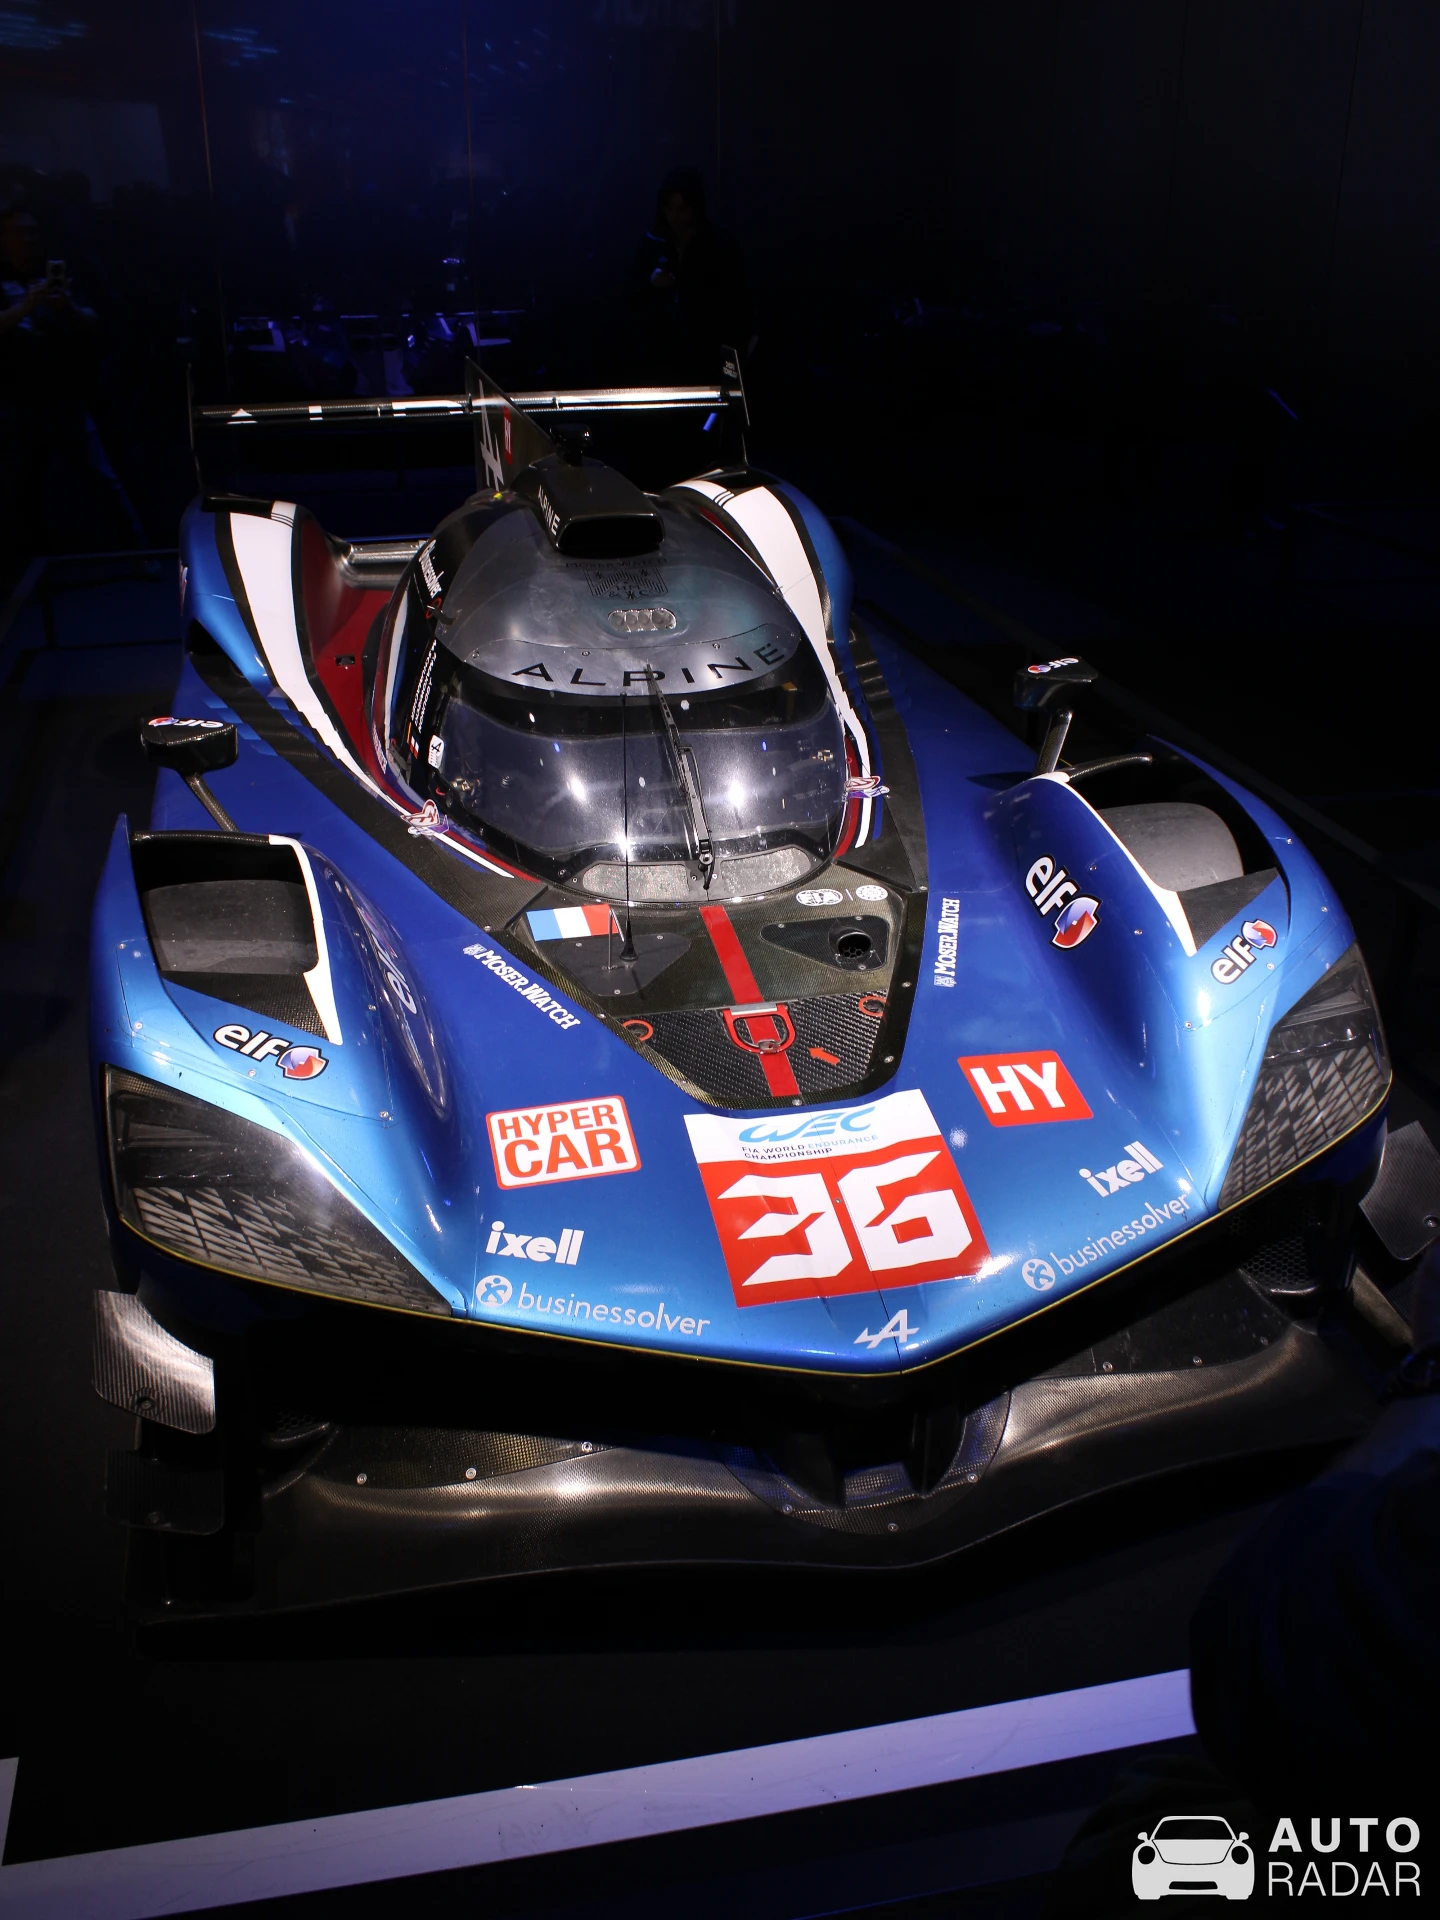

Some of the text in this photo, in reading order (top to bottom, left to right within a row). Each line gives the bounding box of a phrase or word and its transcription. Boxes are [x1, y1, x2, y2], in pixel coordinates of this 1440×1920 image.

[537, 484, 561, 536] ALPINE
[512, 643, 786, 687] ALPINE
[1025, 856, 1078, 916] elf
[370, 933, 417, 1015] elf
[1212, 936, 1257, 984] elf
[474, 949, 581, 1030] MOSER.WATCH
[214, 1024, 291, 1061] elf
[969, 1061, 1066, 1114] HY
[497, 1104, 618, 1141] HYPER
[738, 1106, 876, 1143] WEC
[741, 1134, 879, 1154] FIA WORLD ENDURANCE
[504, 1128, 629, 1179] CAR
[744, 1148, 833, 1160] CHAMPIONSHIP
[1079, 1140, 1164, 1198] ixell
[485, 1221, 585, 1266] ixell
[717, 1150, 973, 1287] 36
[1050, 1193, 1190, 1276] businessolver
[517, 1282, 711, 1336] businessolver
